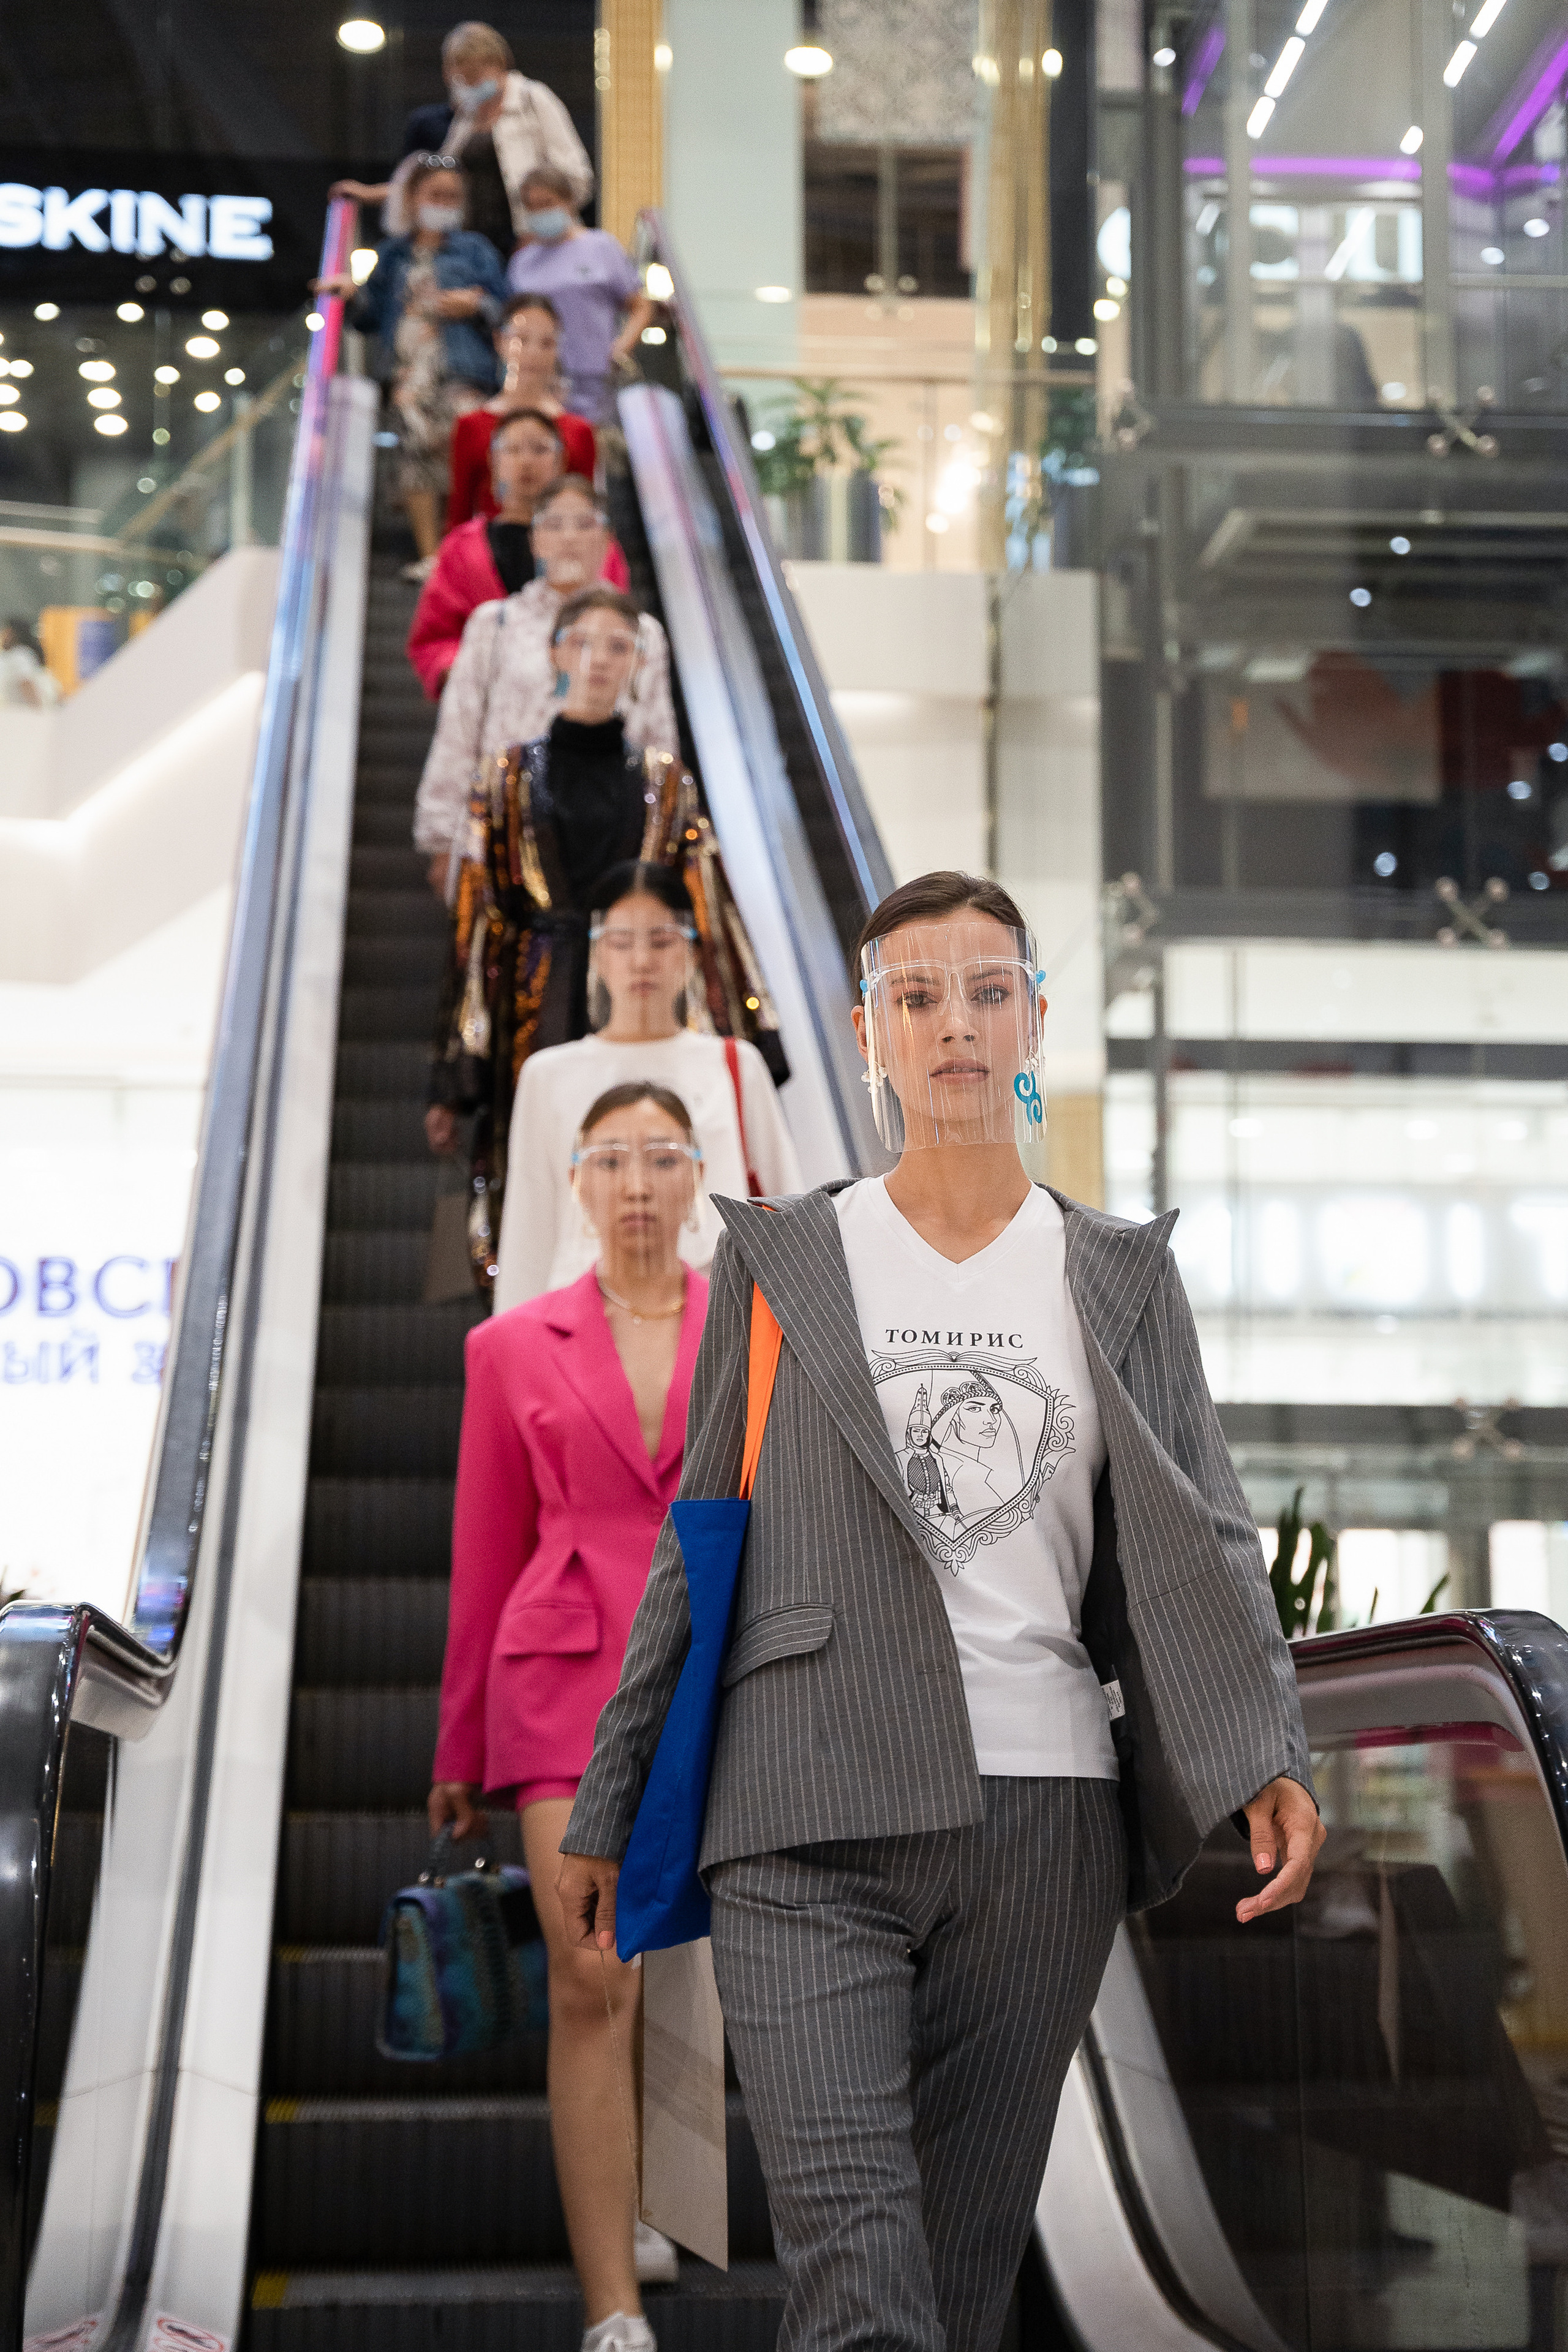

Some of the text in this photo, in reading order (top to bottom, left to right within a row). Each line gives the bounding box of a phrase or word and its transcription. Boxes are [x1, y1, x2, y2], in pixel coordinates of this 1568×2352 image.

[0, 183, 274, 261] SKINE
[0, 1254, 179, 1319] ВС
[131, 1339, 167, 1385] З
[885, 1328, 1024, 1349] ТОМИРИС
